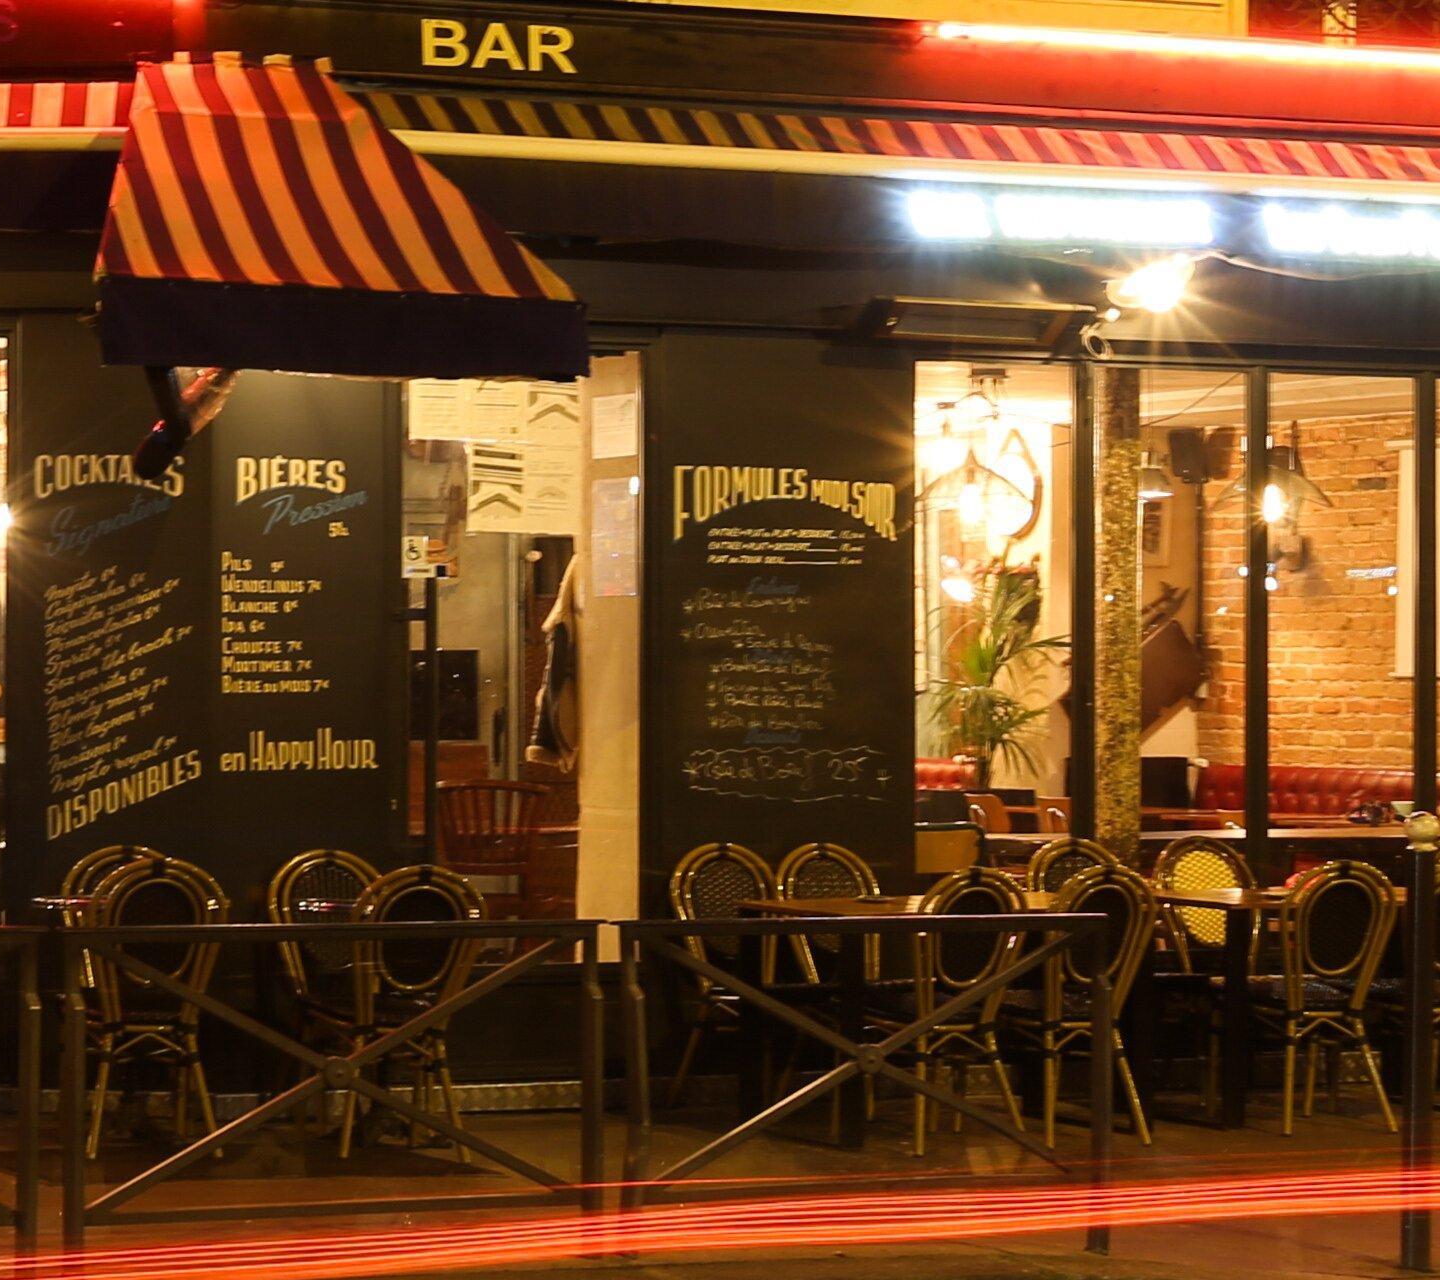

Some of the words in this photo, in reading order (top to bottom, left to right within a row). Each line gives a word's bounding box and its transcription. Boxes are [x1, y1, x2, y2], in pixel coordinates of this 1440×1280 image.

[420, 18, 578, 75] BAR
[34, 453, 186, 500] COCKTAS
[672, 465, 809, 541] FORMULES
[221, 594, 279, 613] BLANCHE
[220, 751, 247, 772] en
[249, 729, 315, 772] HAPPY
[316, 726, 380, 770] HOUR
[46, 748, 203, 842] DISPONIBLES
